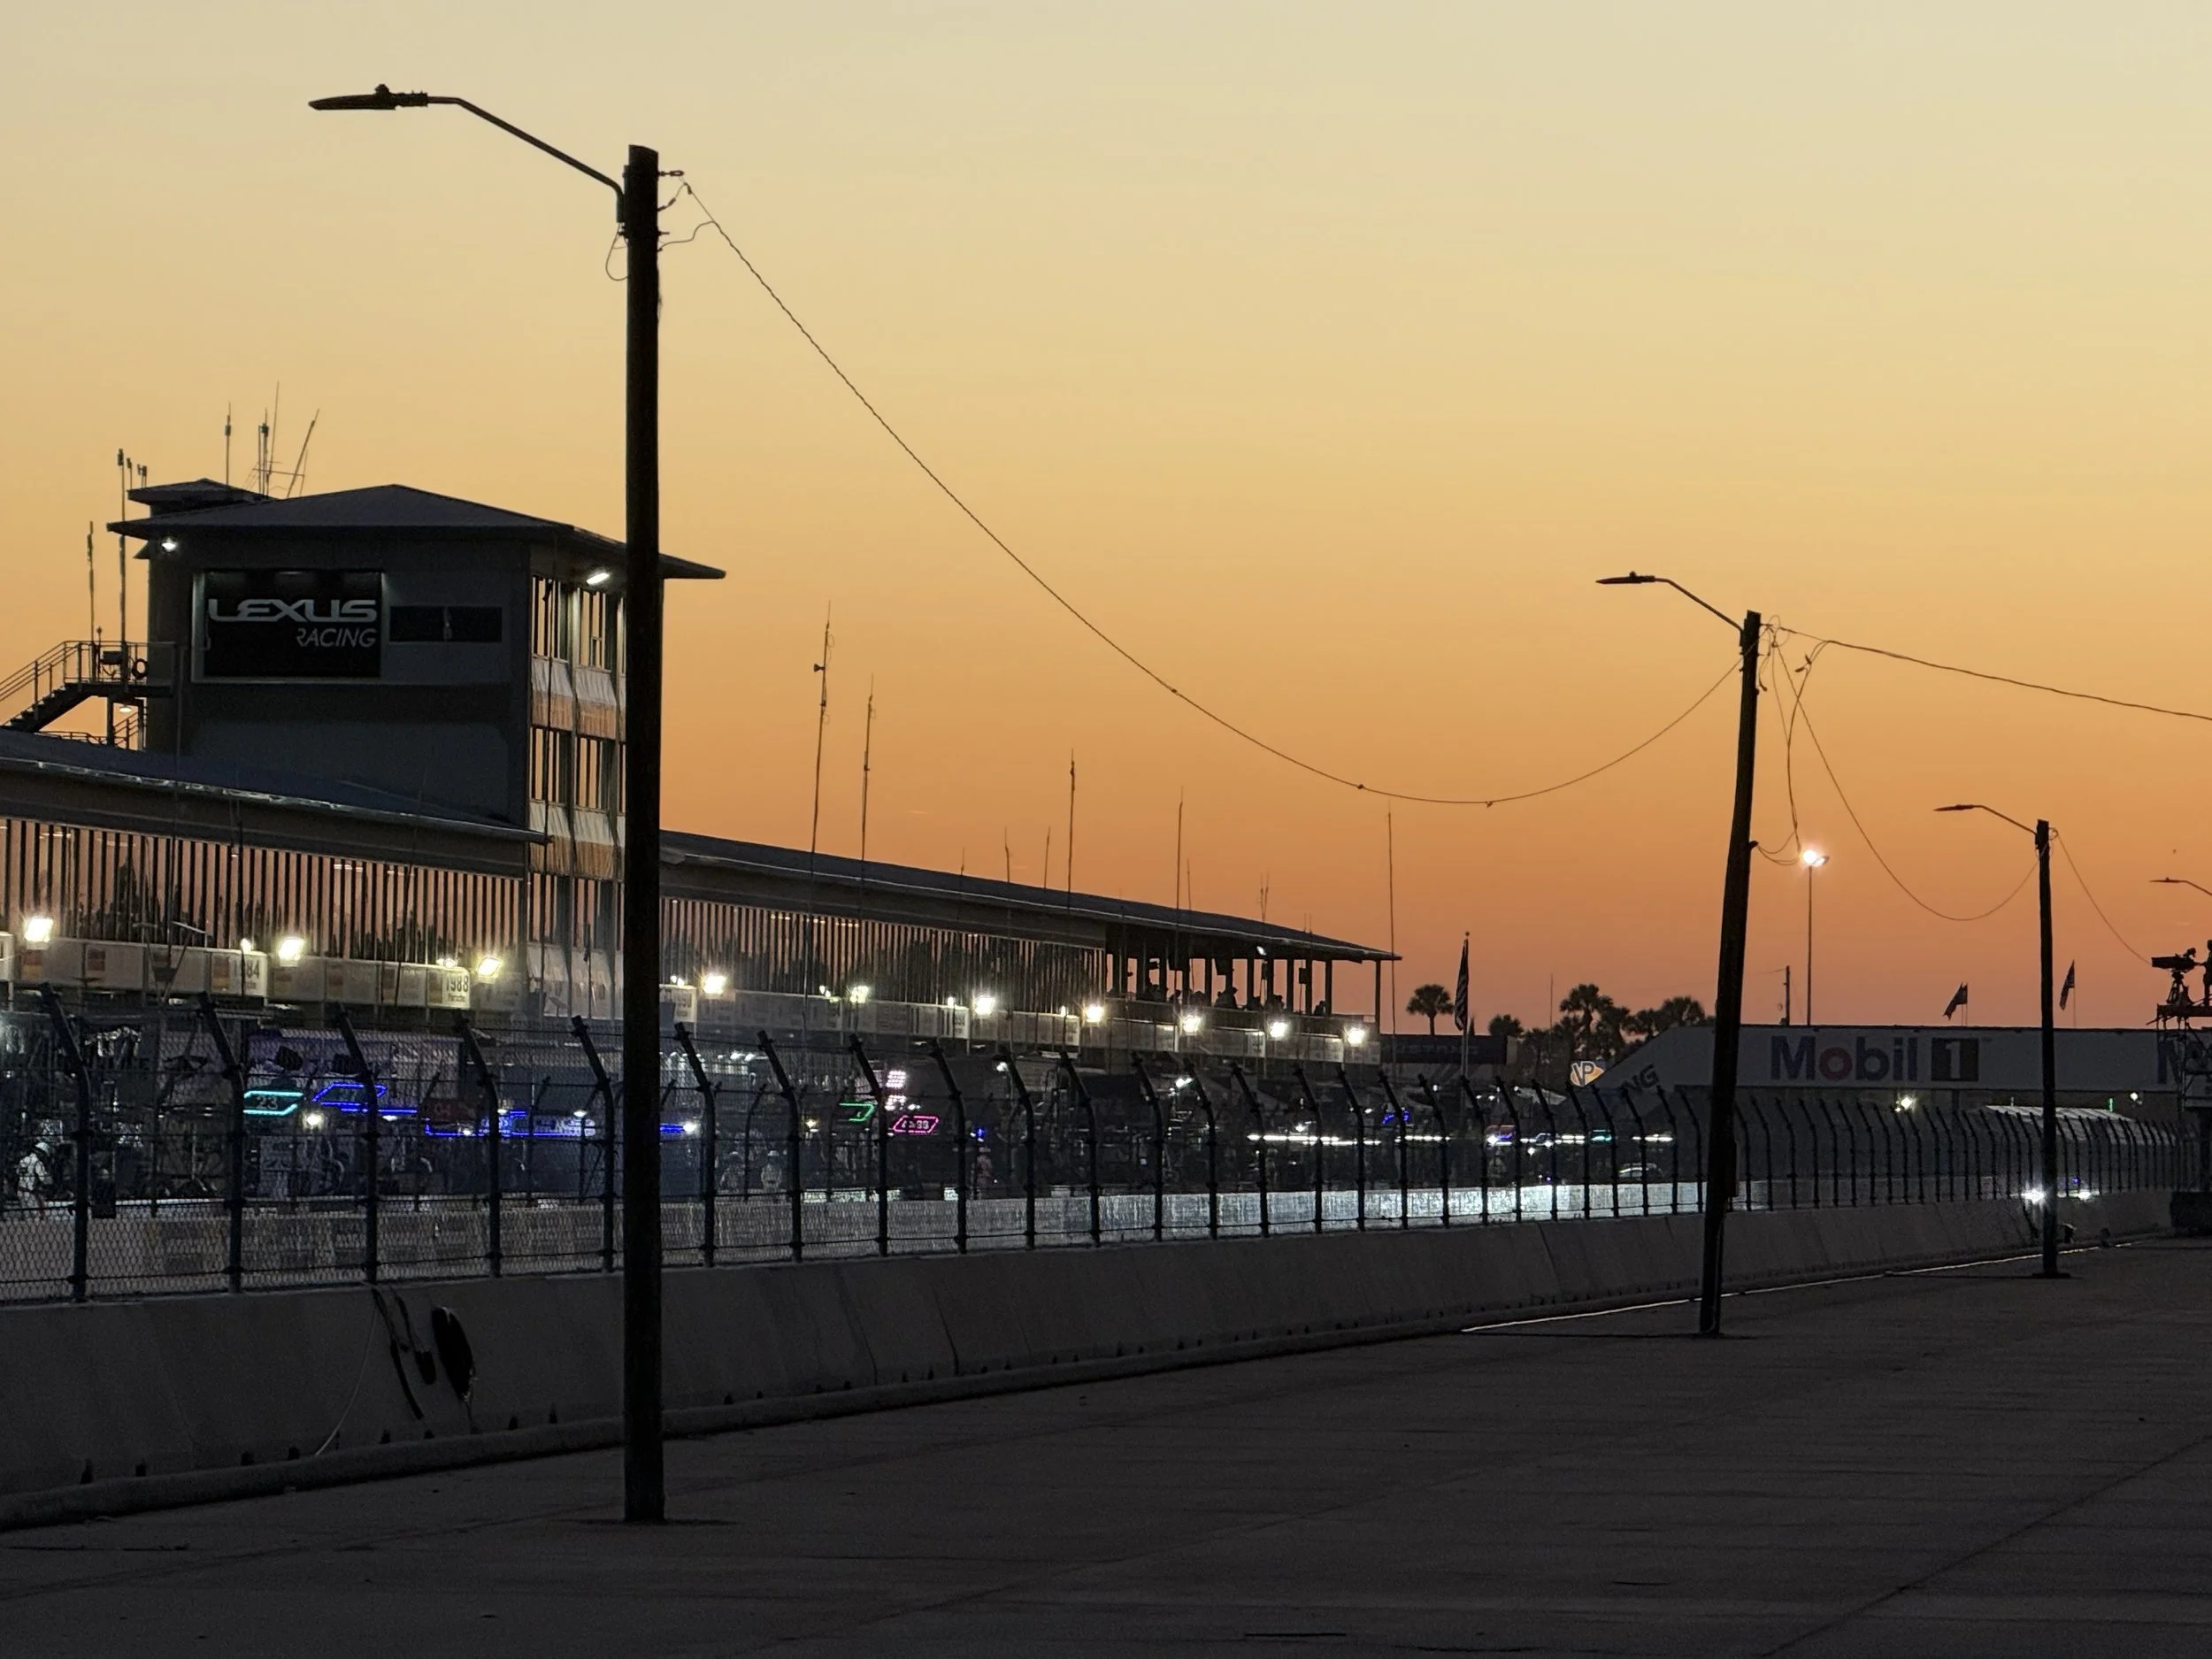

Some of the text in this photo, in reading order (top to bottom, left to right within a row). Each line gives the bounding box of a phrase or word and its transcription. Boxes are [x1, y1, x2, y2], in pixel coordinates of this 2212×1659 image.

[208, 599, 378, 622] LEXUS
[296, 627, 378, 648] RACING
[446, 975, 469, 993] 1988
[1770, 1035, 1917, 1080] Mobil
[1571, 1061, 1595, 1087] VP
[256, 1095, 278, 1110] 23
